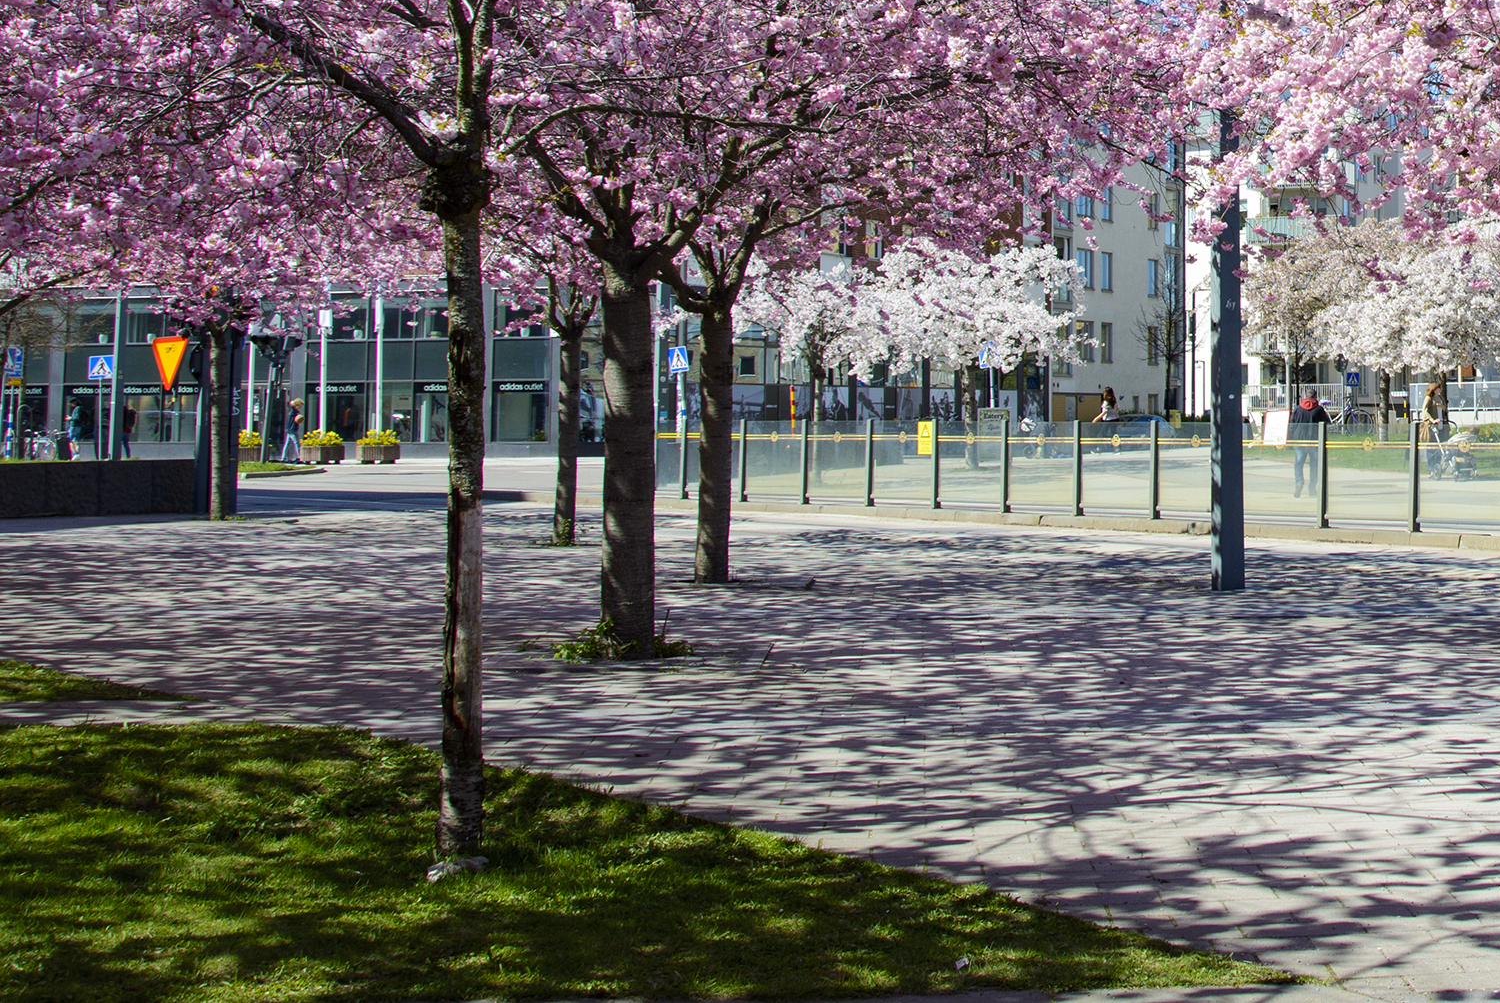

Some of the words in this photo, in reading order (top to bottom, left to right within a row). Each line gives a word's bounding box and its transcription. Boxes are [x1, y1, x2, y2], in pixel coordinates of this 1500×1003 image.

[72, 386, 94, 394] adidas
[142, 386, 161, 394] outlet
[315, 384, 338, 393] adas
[339, 384, 357, 393] outlet
[423, 383, 447, 392] adidas
[499, 382, 523, 391] adidas
[524, 382, 544, 391] outlet
